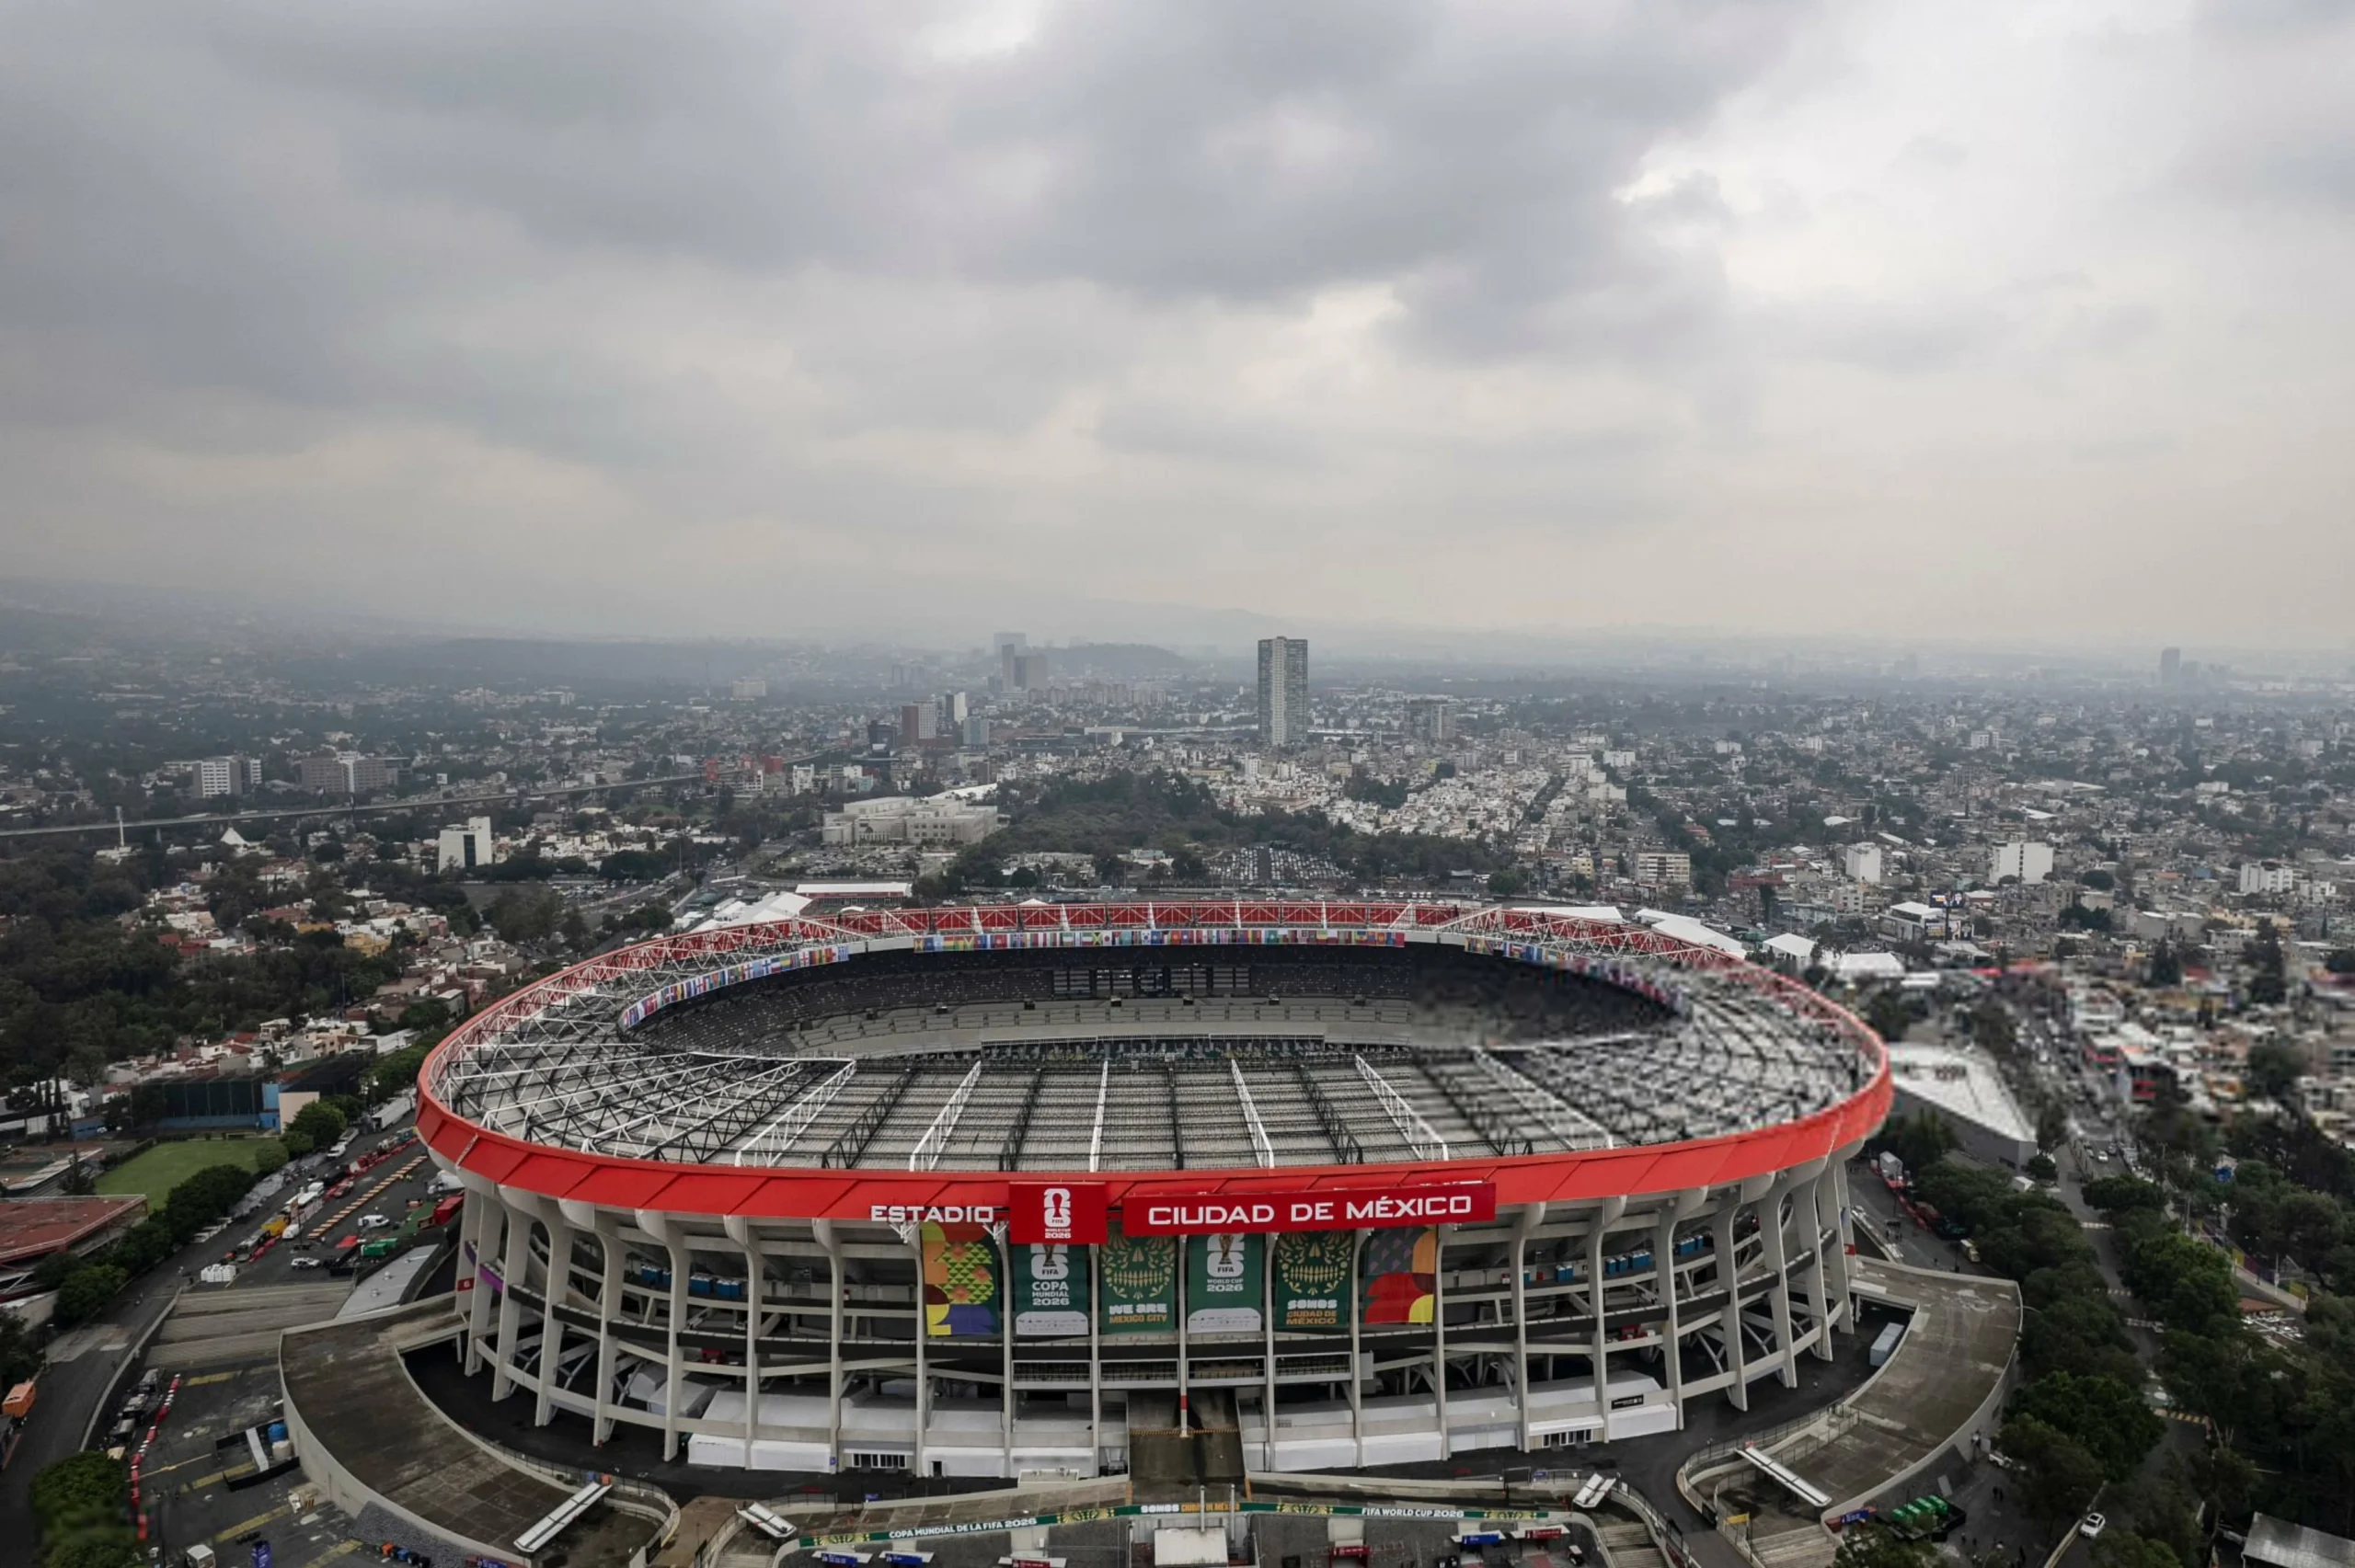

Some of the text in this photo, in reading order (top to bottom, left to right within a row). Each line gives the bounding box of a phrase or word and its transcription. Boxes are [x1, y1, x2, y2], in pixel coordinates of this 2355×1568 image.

[871, 1206, 994, 1222] ESTADIO
[1148, 1196, 1472, 1225] CIUDAD DE MÉXICO
[1031, 1281, 1069, 1291] COPA
[1207, 1284, 1244, 1292] 2026
[1032, 1298, 1070, 1306] 2026
[1287, 1299, 1338, 1310] SOMOS
[1109, 1303, 1167, 1314] WE ARE
[1147, 1314, 1166, 1322] CITY
[1140, 1504, 1179, 1513] SOMOS
[1361, 1507, 1381, 1516] FIFA
[1382, 1508, 1414, 1516] WORLD
[1433, 1509, 1465, 1517] 2026
[889, 1517, 1038, 1539] COPA MUNDIAL DE LA FIFA 2026
